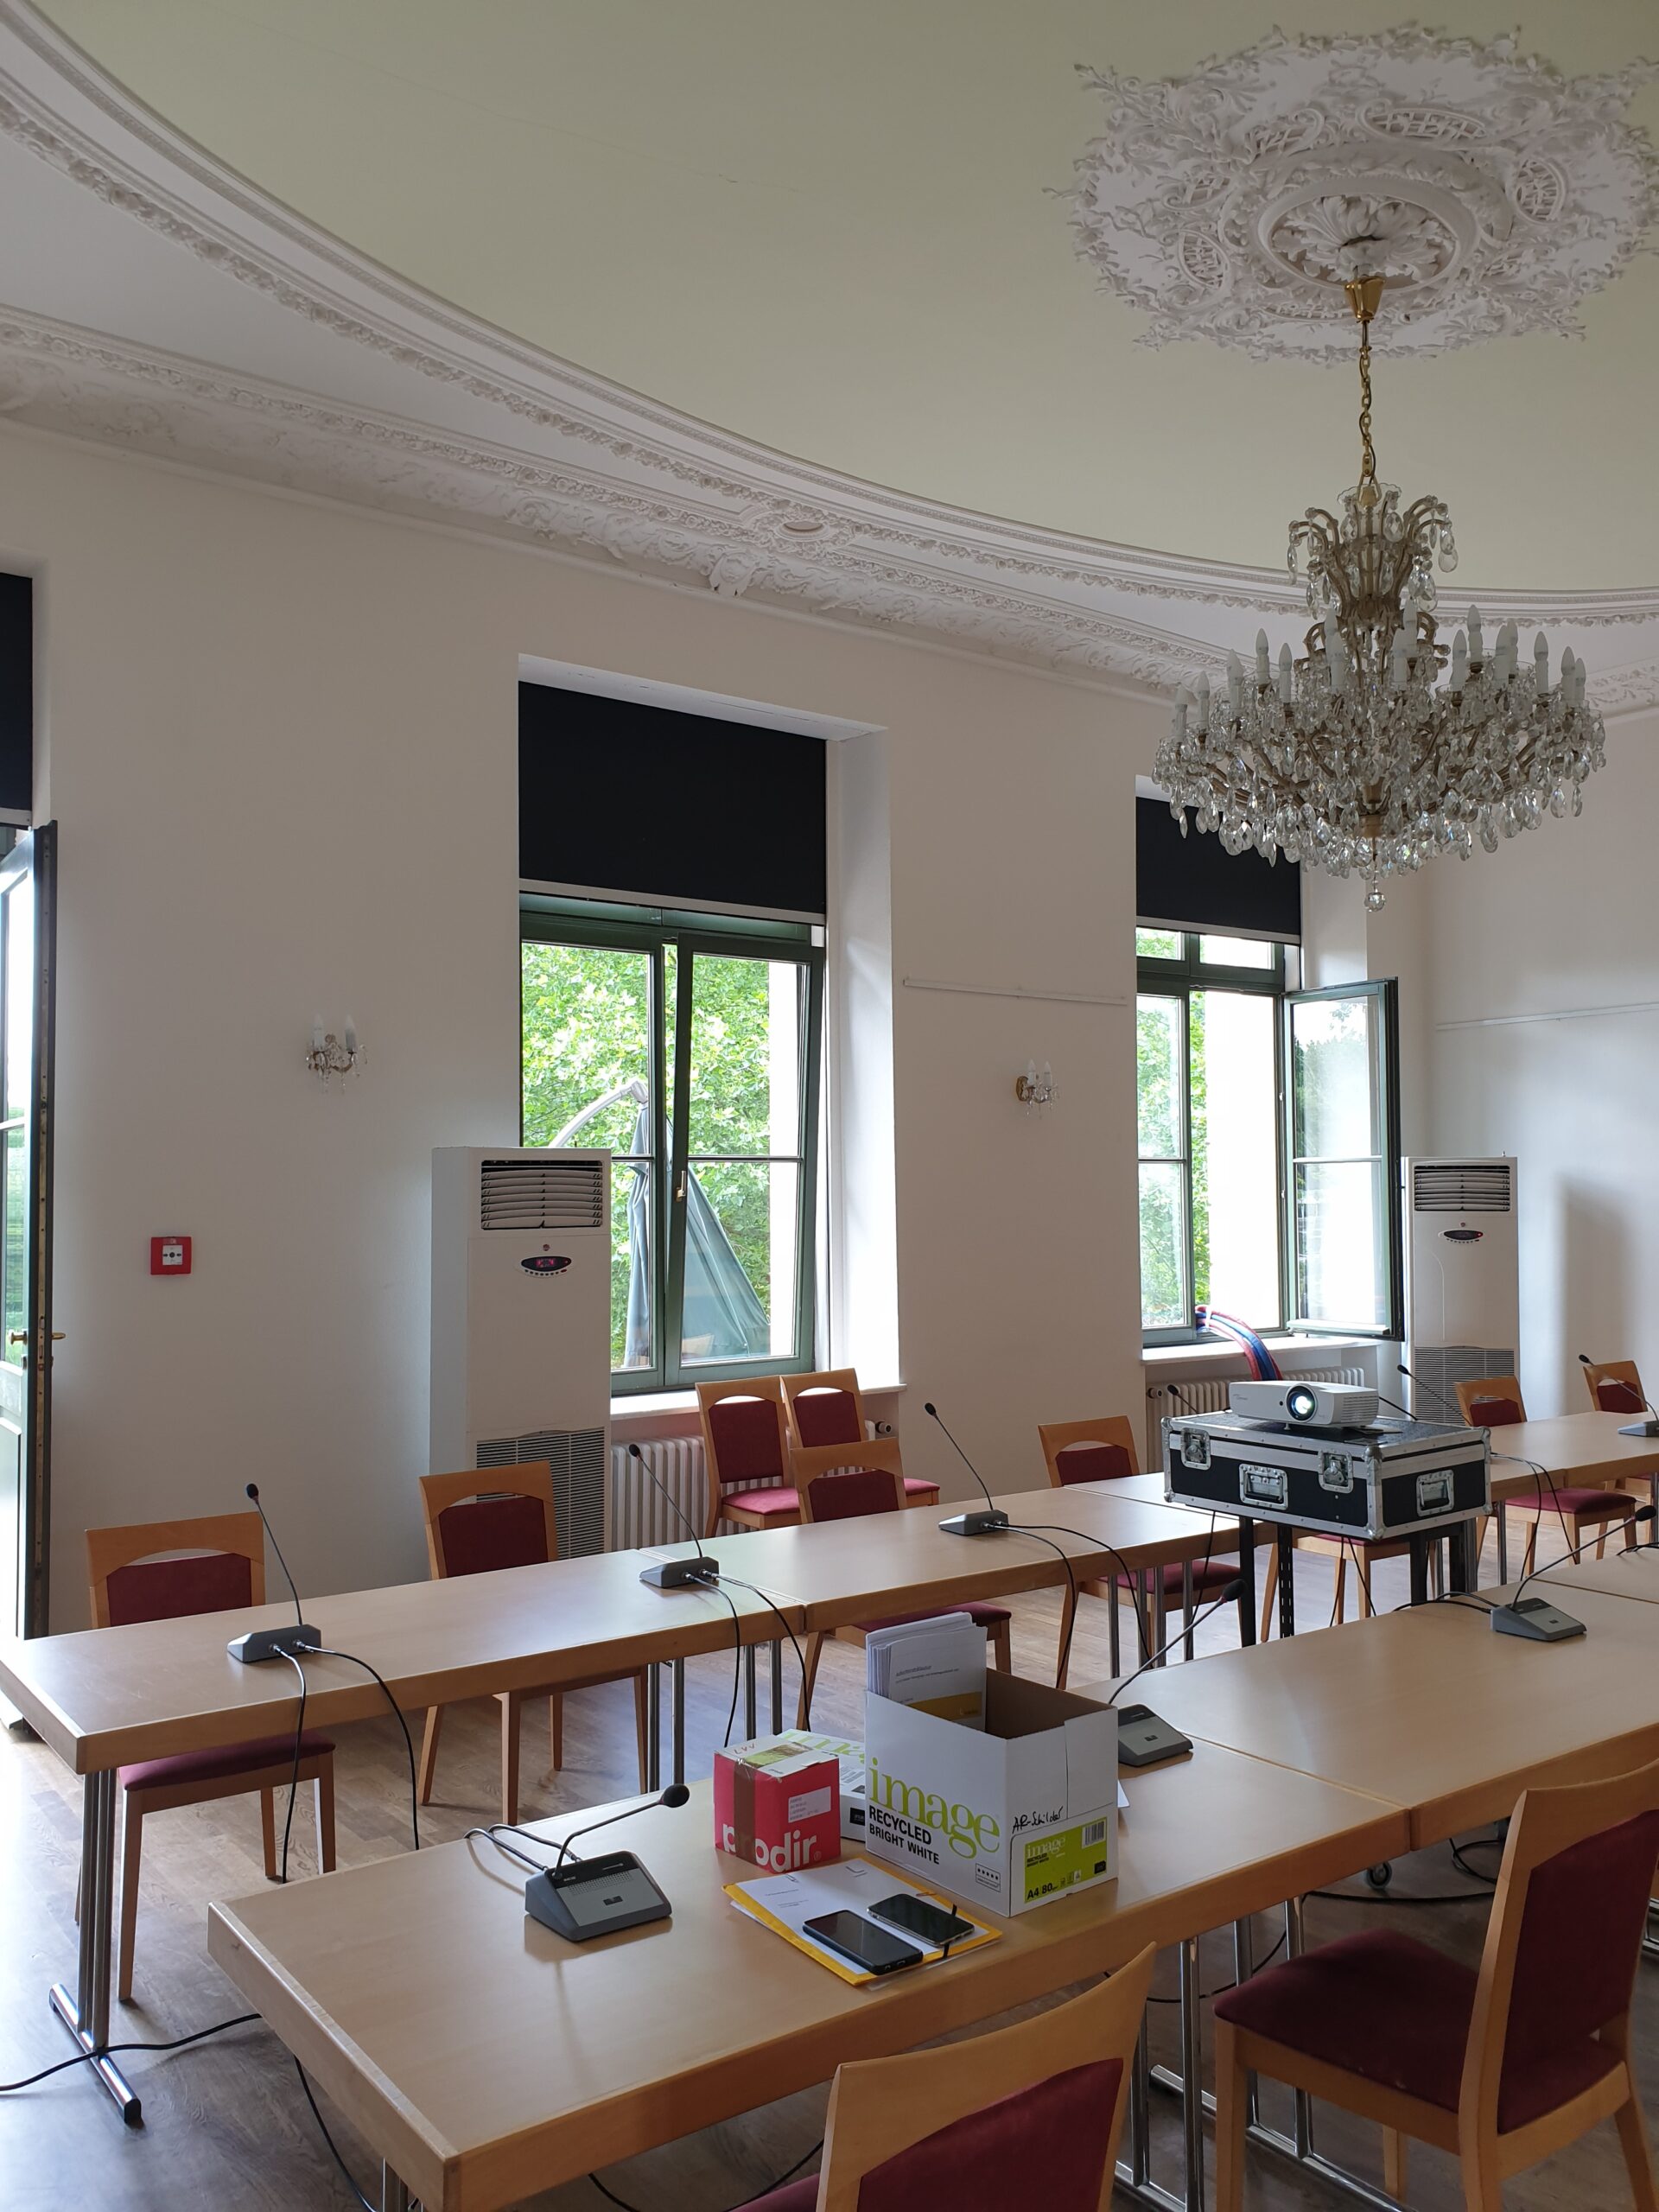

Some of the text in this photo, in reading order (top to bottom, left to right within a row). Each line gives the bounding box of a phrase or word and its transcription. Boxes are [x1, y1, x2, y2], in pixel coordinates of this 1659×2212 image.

[868, 1757, 1000, 1859] image
[869, 1805, 932, 1846] RECYCLED
[722, 1823, 817, 1873] podir
[869, 1823, 940, 1865] BRIGHT WHITE
[1027, 1836, 1065, 1858] image
[1027, 1887, 1039, 1900] A4
[1042, 1882, 1053, 1894] 80
